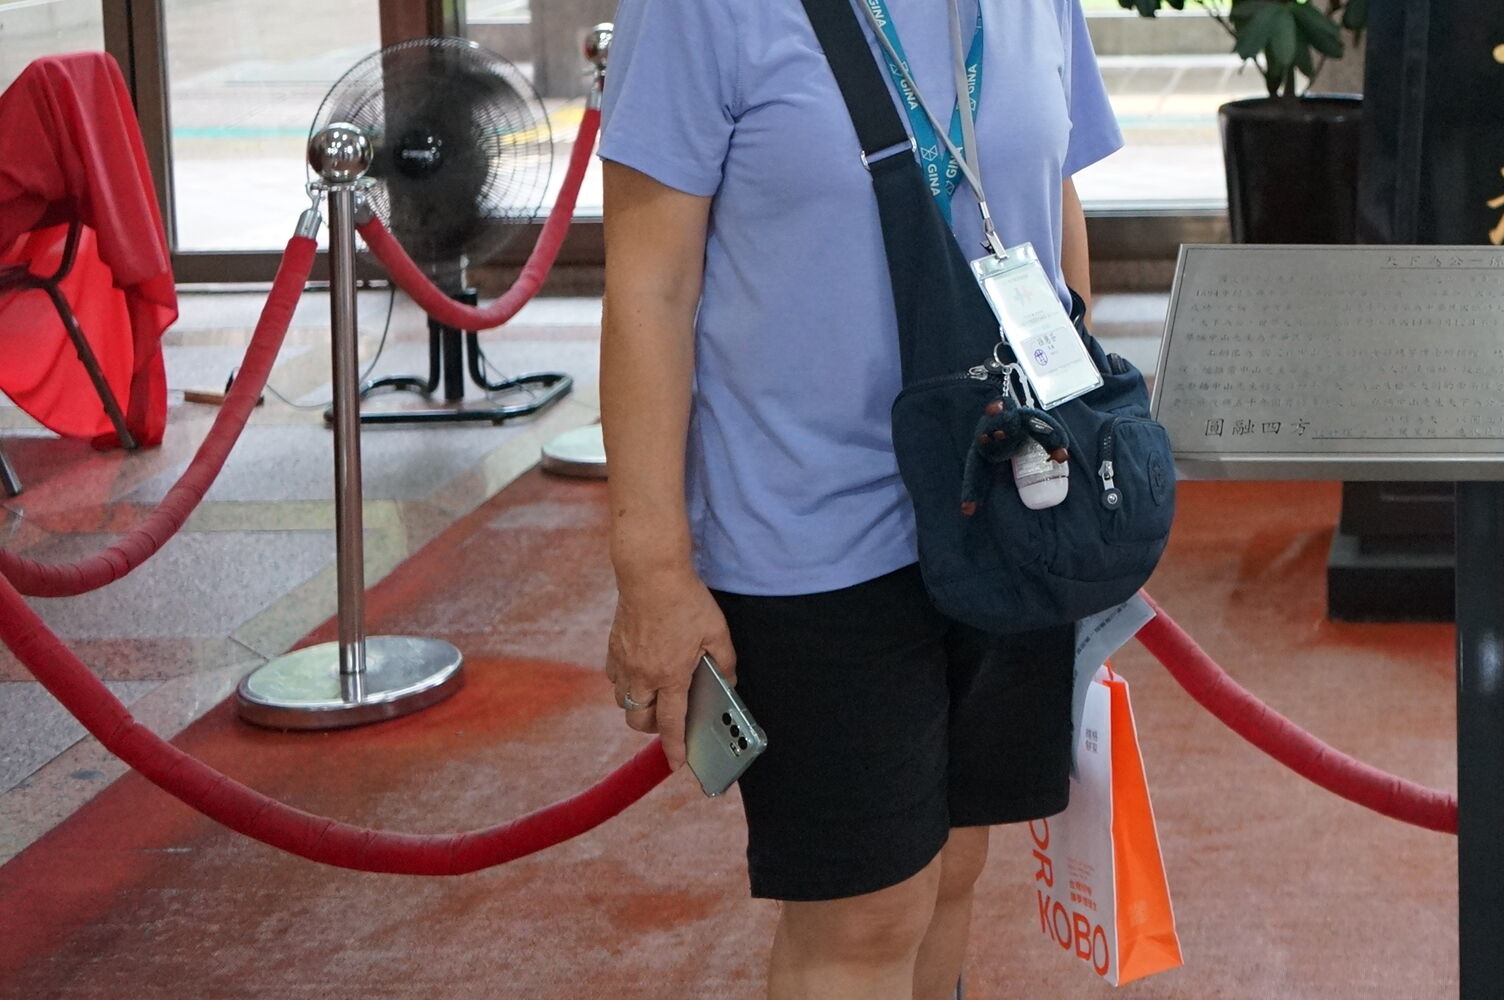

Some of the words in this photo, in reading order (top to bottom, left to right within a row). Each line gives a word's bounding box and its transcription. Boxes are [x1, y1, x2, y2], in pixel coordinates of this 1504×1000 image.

[900, 79, 920, 111] GINA
[927, 163, 941, 196] GINA
[1037, 889, 1110, 977] KOBO
